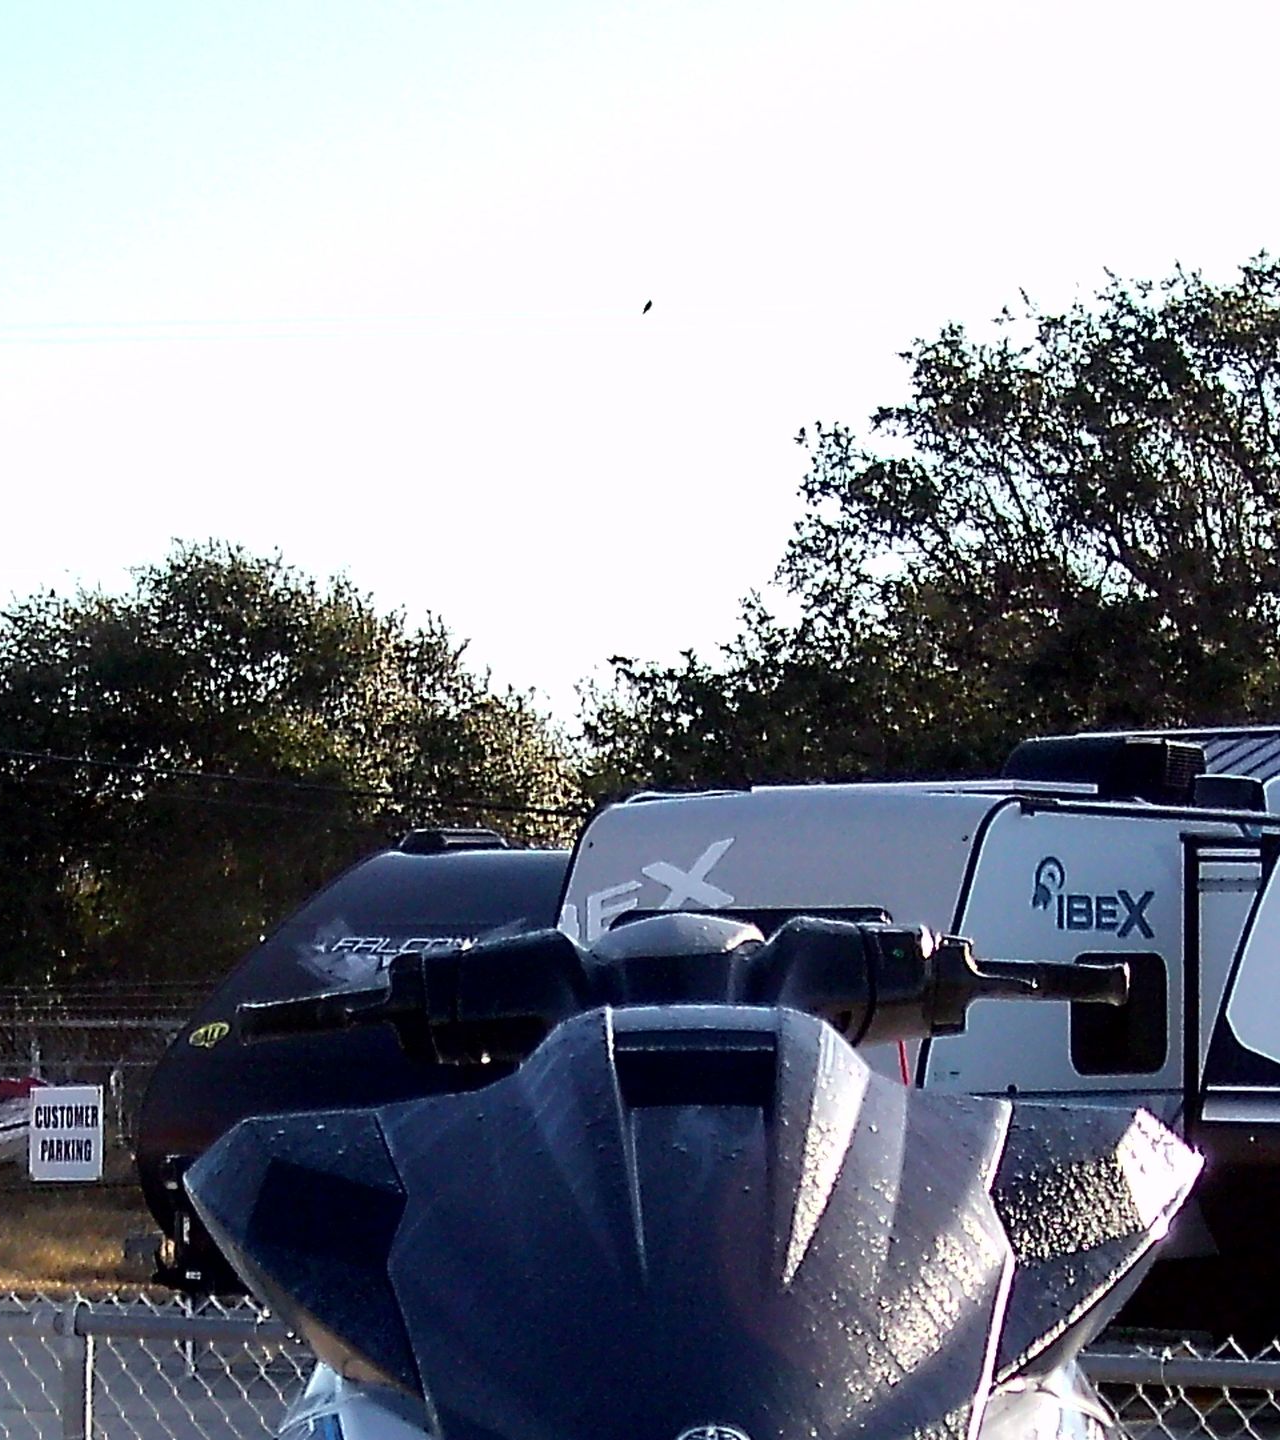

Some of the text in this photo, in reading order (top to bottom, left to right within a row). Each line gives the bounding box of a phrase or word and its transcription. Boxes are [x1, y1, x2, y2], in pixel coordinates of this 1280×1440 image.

[1057, 889, 1155, 939] IBEX
[35, 1105, 98, 1128] CUSTOMER
[41, 1139, 91, 1161] PARKING
